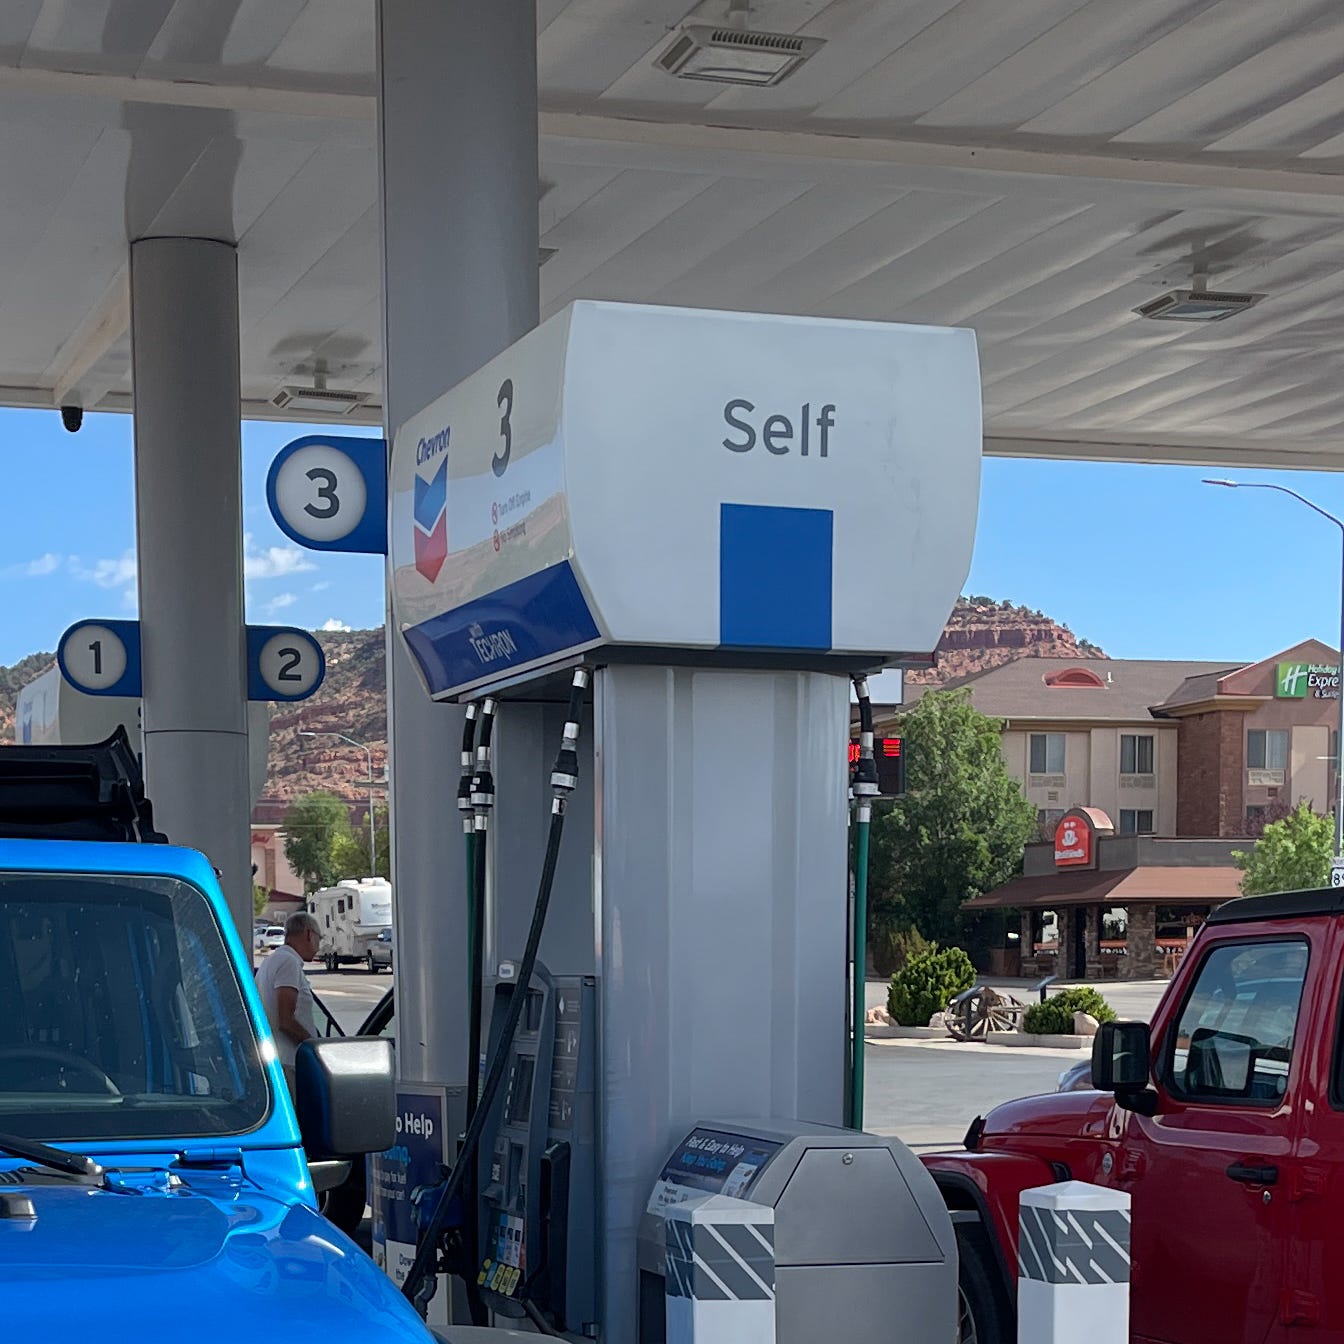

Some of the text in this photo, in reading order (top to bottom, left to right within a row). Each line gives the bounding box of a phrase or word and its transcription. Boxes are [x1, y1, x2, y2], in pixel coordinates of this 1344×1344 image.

[416, 425, 450, 466] Chevron
[492, 378, 514, 477] 3
[722, 398, 837, 457] Self
[304, 468, 340, 519] 3
[89, 641, 102, 674] 1
[278, 648, 302, 681] 2
[405, 1112, 433, 1140] Help
